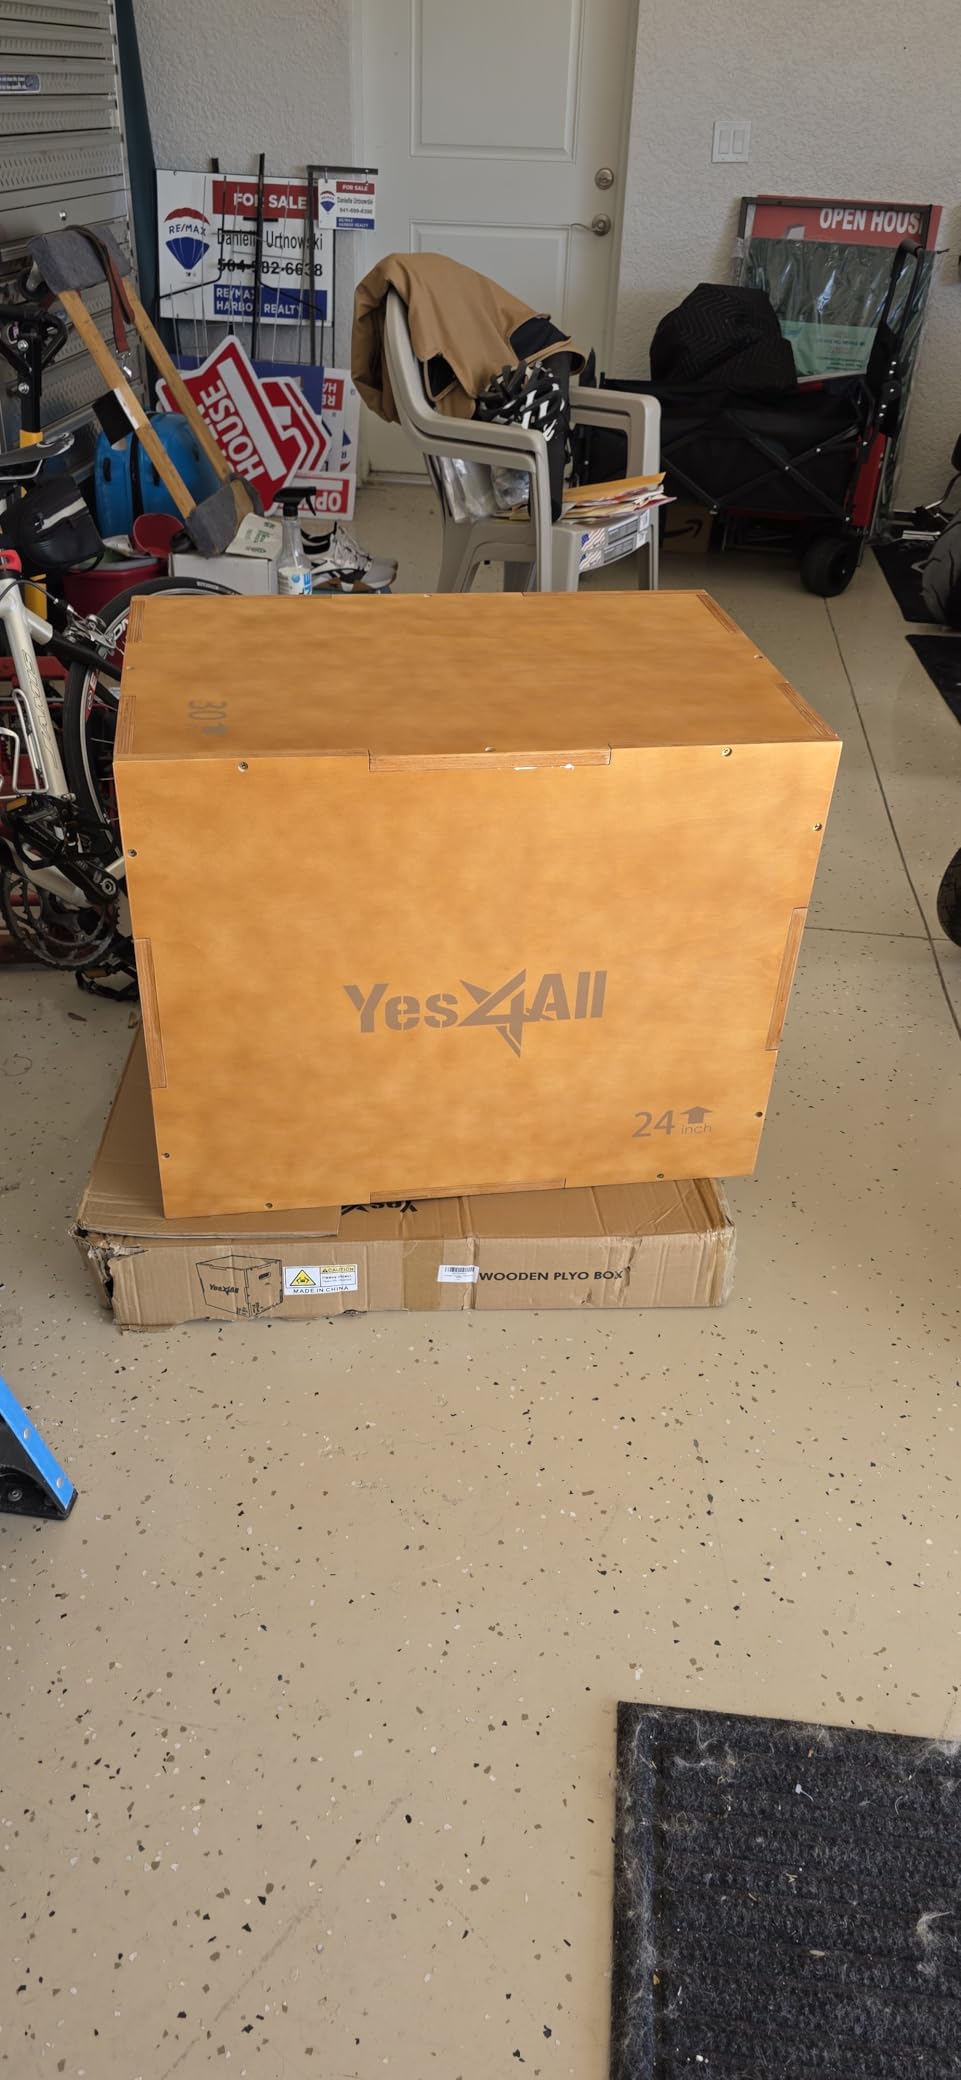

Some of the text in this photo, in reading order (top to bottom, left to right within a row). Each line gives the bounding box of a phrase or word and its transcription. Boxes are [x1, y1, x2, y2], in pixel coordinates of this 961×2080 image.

[268, 194, 307, 210] SALE
[168, 223, 206, 236] RE/MAX
[819, 207, 922, 234] OPEN HOUS
[217, 228, 258, 247] Daniell
[216, 300, 254, 312] HARBO
[200, 379, 265, 482] HOUSE
[343, 968, 608, 1059] Yes4All
[631, 1109, 712, 1138] 24 inch
[478, 1272, 549, 1281] WOODEN
[553, 1271, 590, 1281] PLYO
[594, 1270, 623, 1280] BOX
